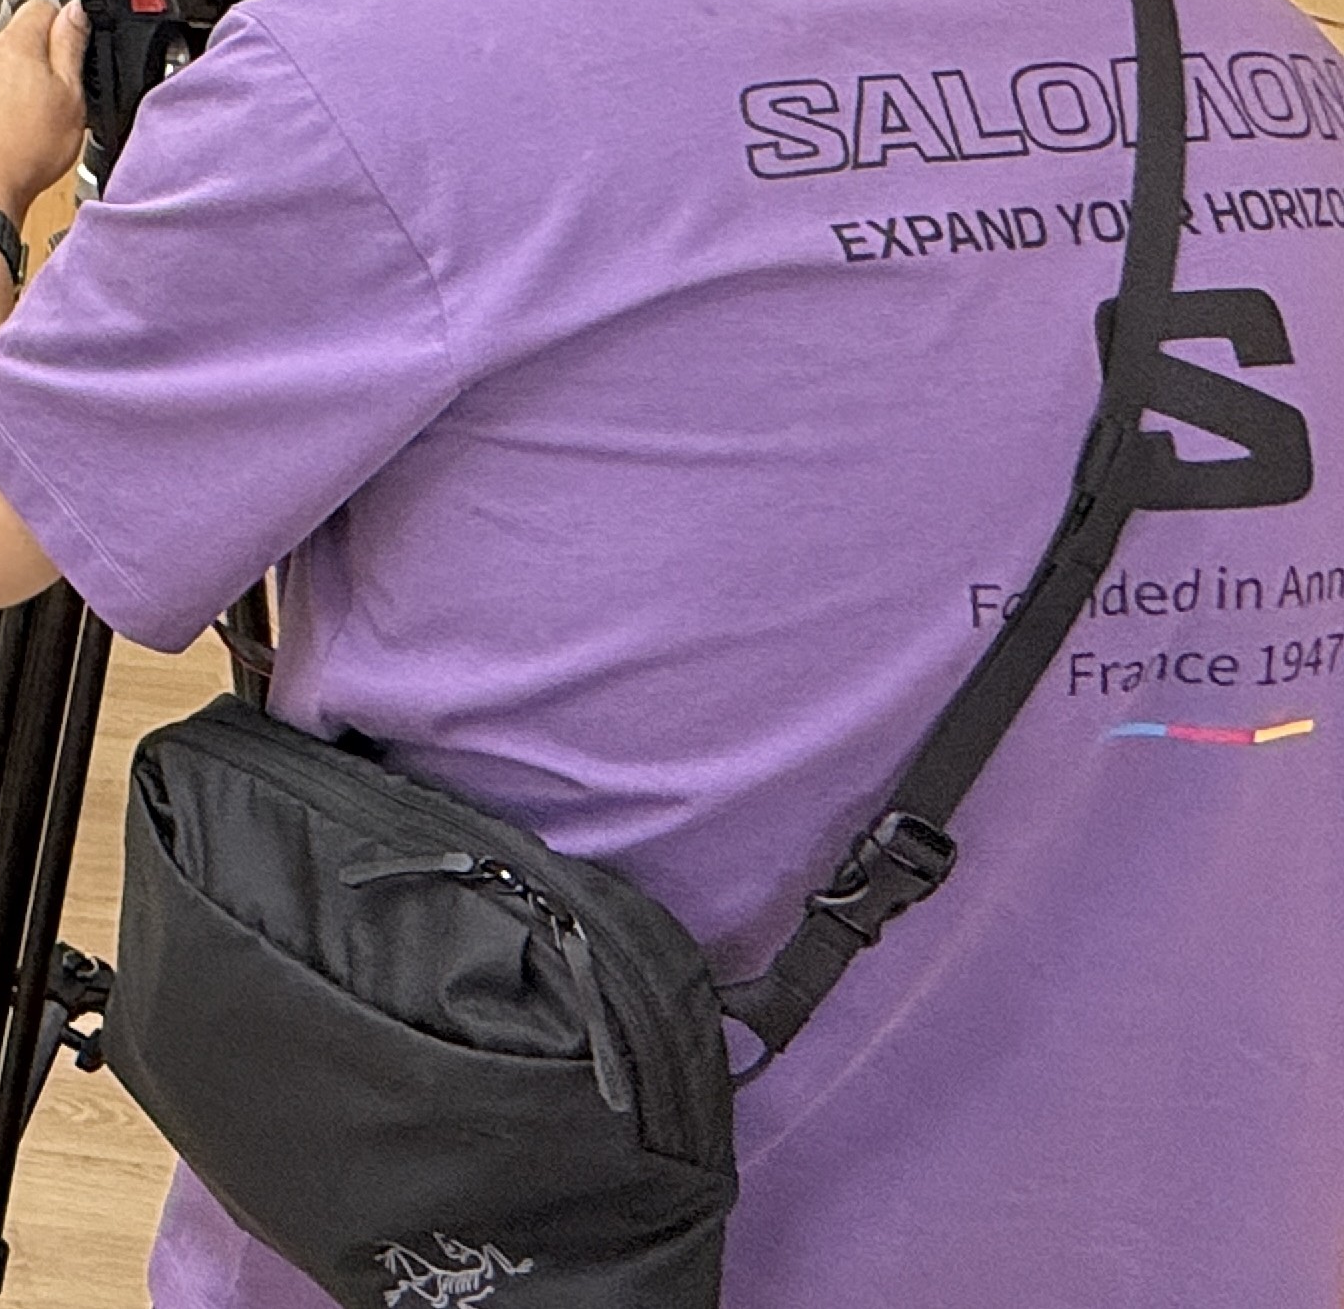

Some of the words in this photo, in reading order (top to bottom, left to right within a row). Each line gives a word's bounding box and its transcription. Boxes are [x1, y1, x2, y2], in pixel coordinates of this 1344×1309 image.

[830, 206, 1047, 263] EXPAND
[1216, 566, 1263, 610] in
[1067, 651, 1241, 696] France
[1255, 633, 1344, 686] 1947
